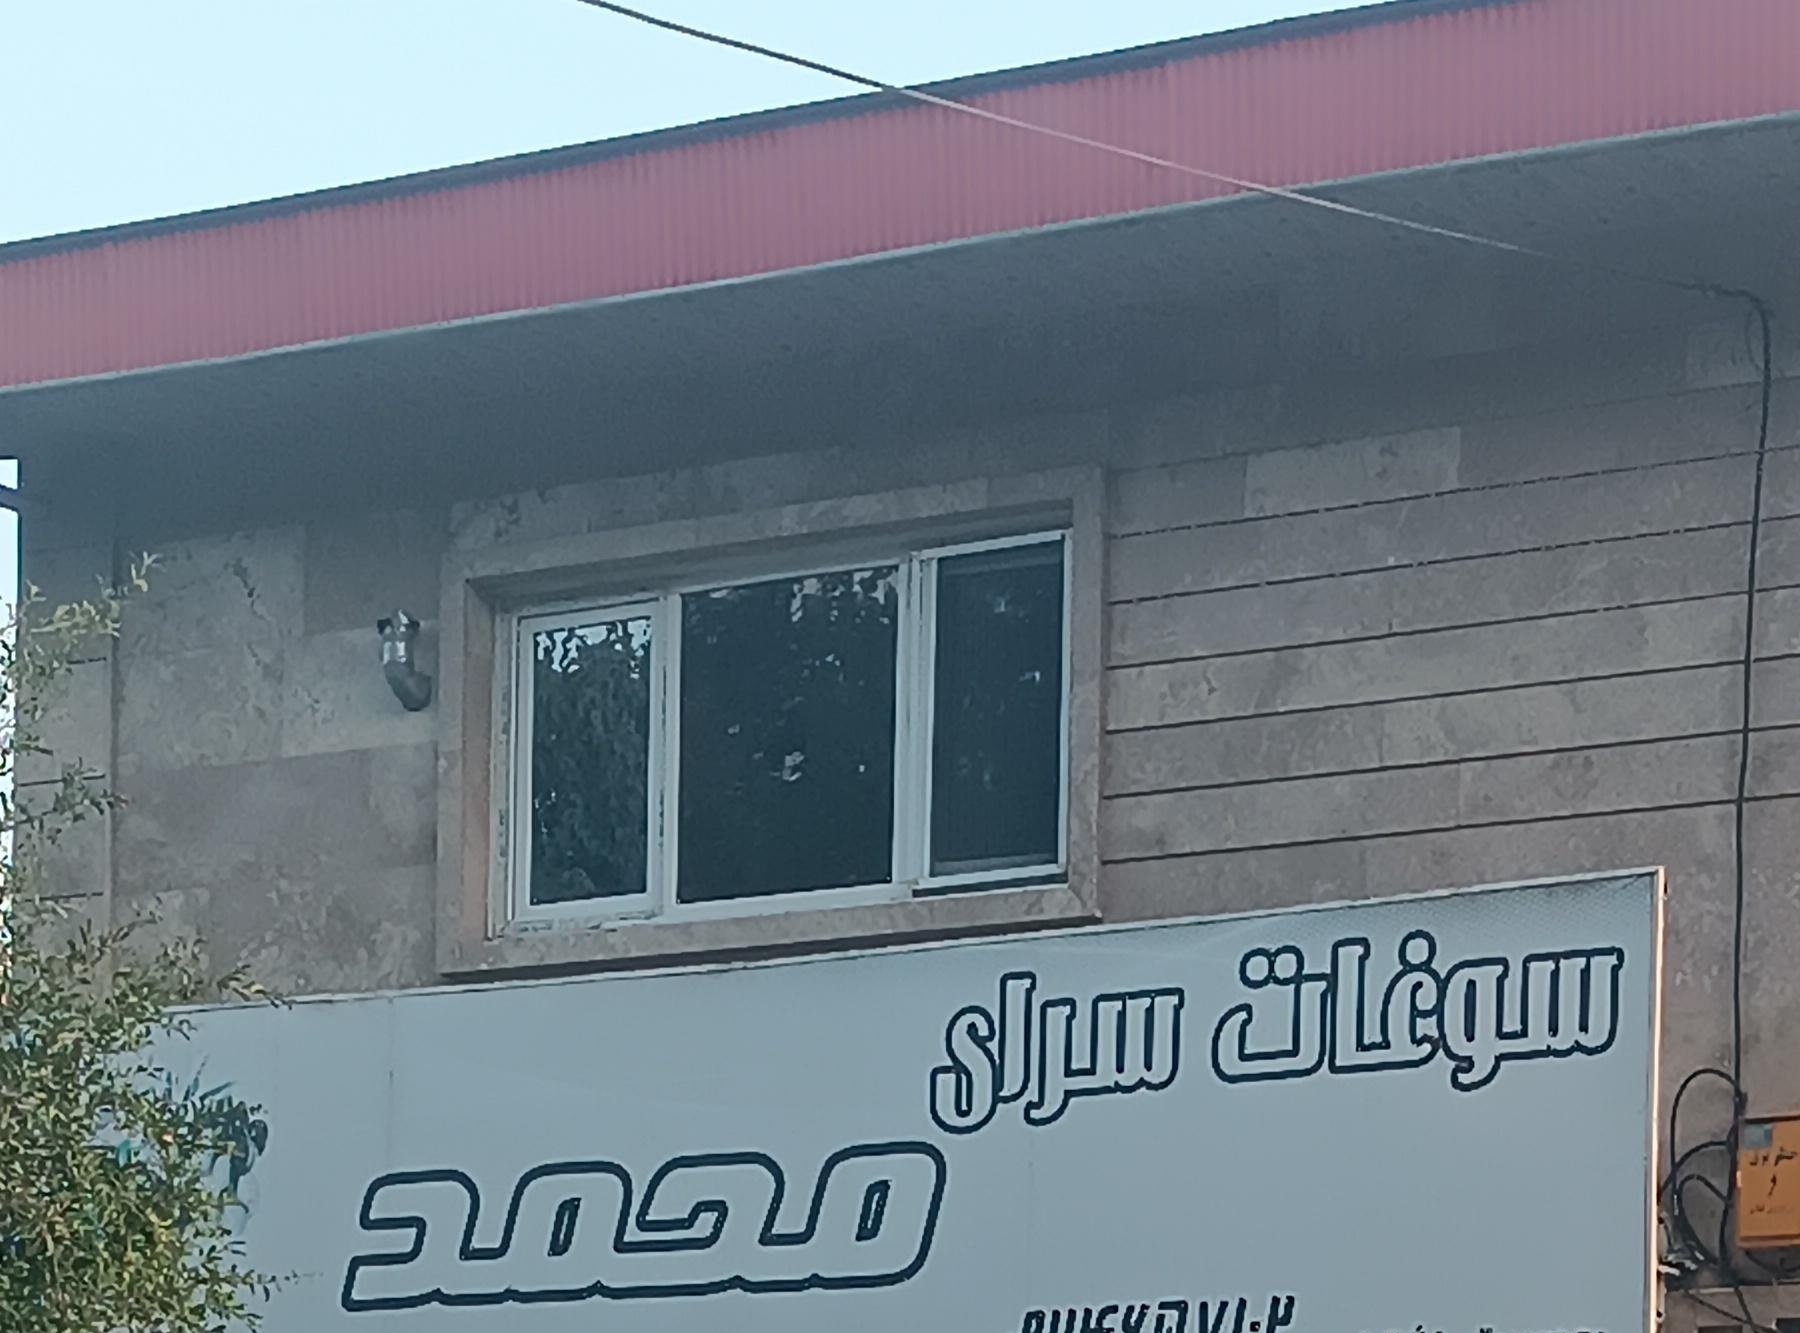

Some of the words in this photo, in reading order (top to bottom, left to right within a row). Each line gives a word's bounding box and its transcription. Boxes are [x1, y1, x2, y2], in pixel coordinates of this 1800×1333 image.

[929, 972, 1185, 1134] سرای
[1211, 929, 1625, 1092] سوغات
[341, 1140, 947, 1312] محمد
